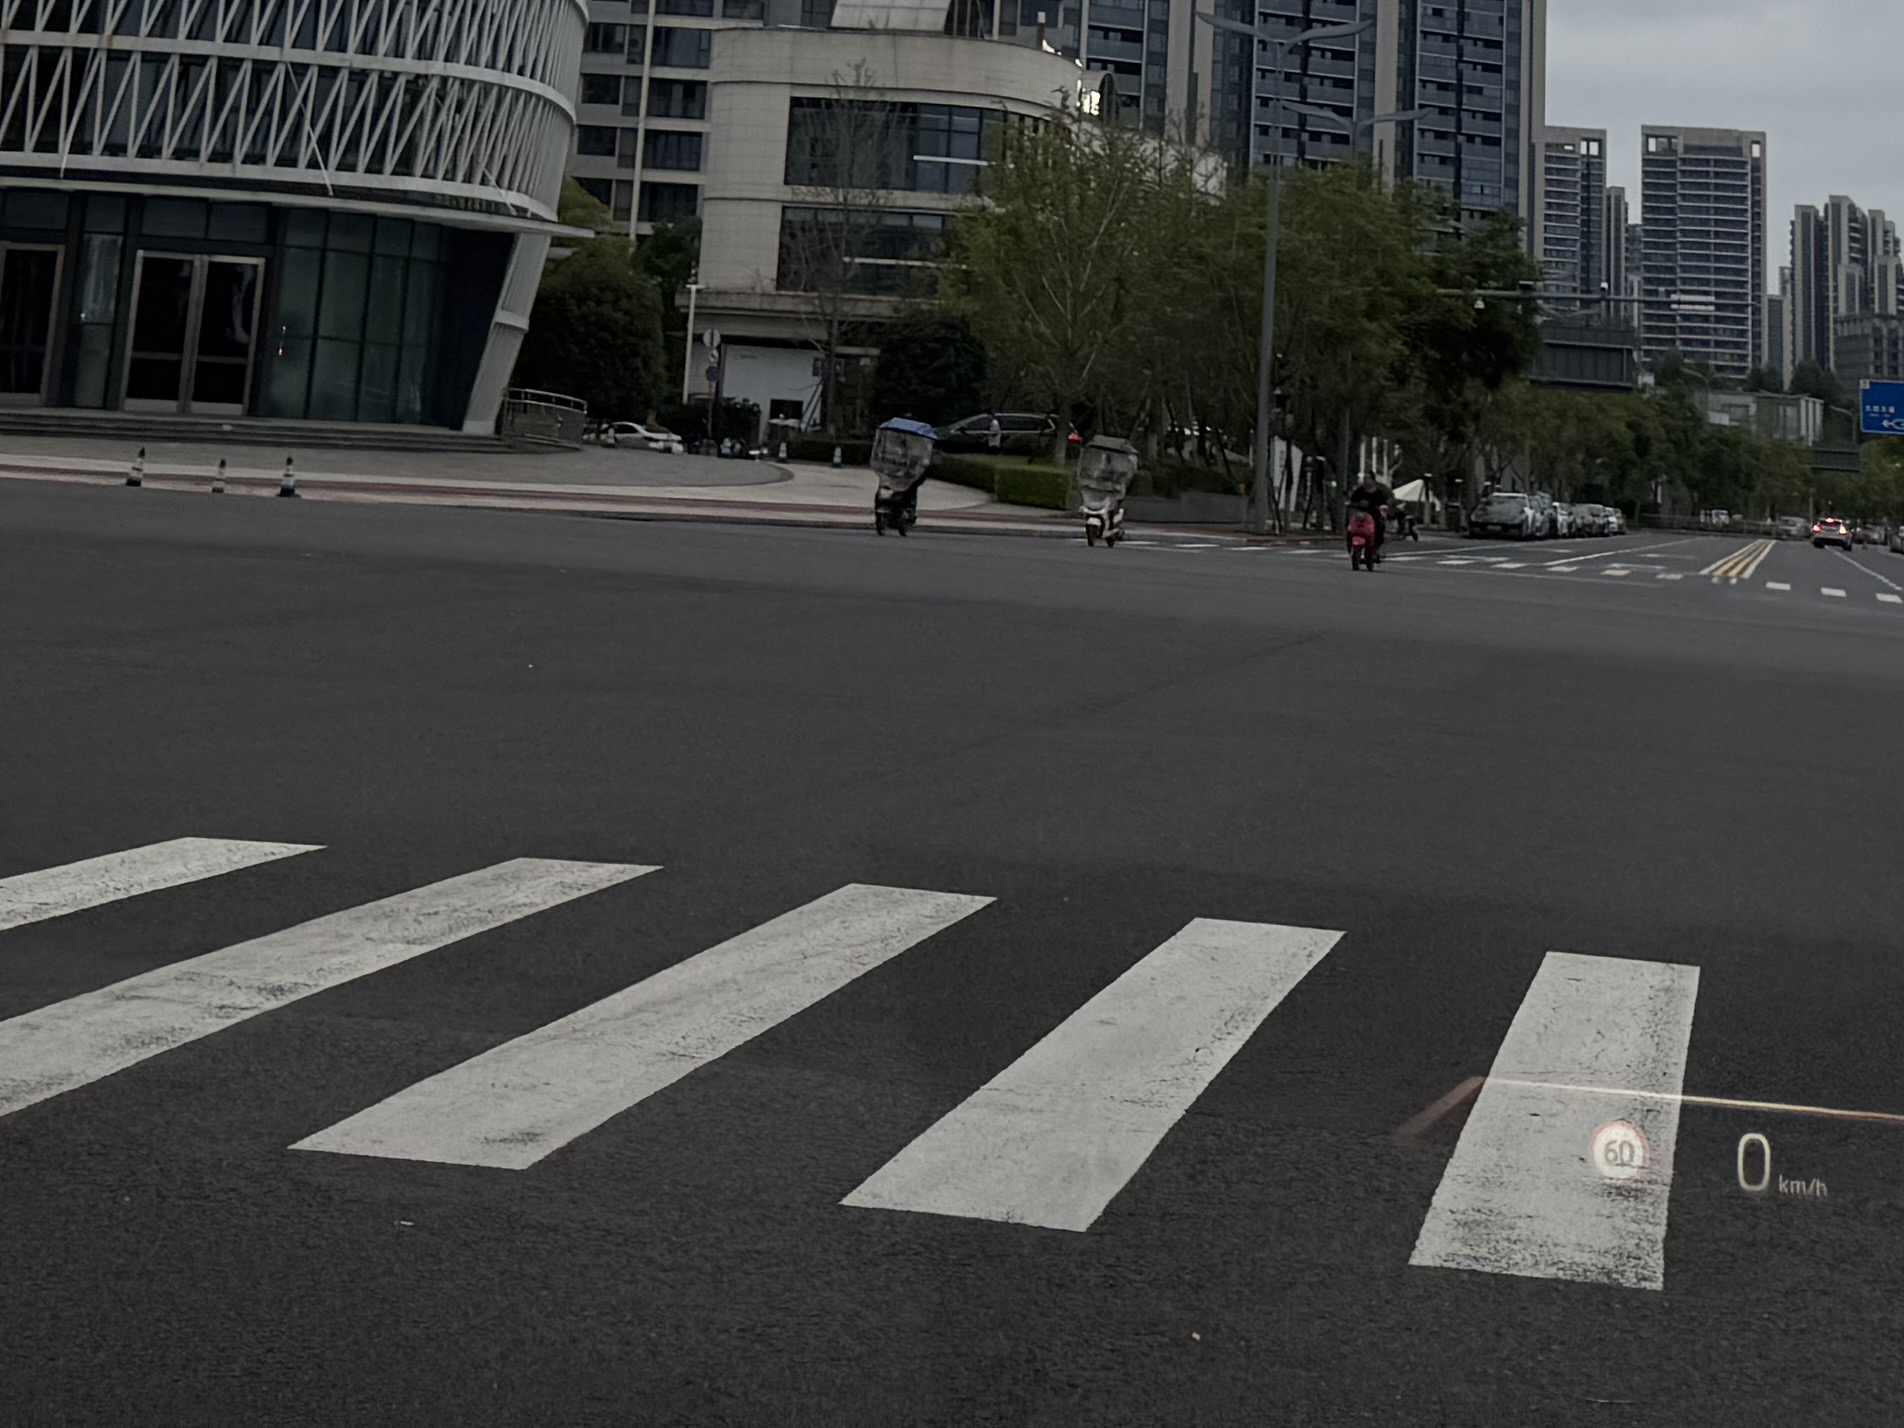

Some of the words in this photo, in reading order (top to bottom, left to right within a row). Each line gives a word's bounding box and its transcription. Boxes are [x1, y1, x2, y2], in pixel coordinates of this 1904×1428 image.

[1605, 1140, 1635, 1164] 60
[1737, 1133, 1771, 1191] 0
[1778, 1175, 1828, 1198] km/h
